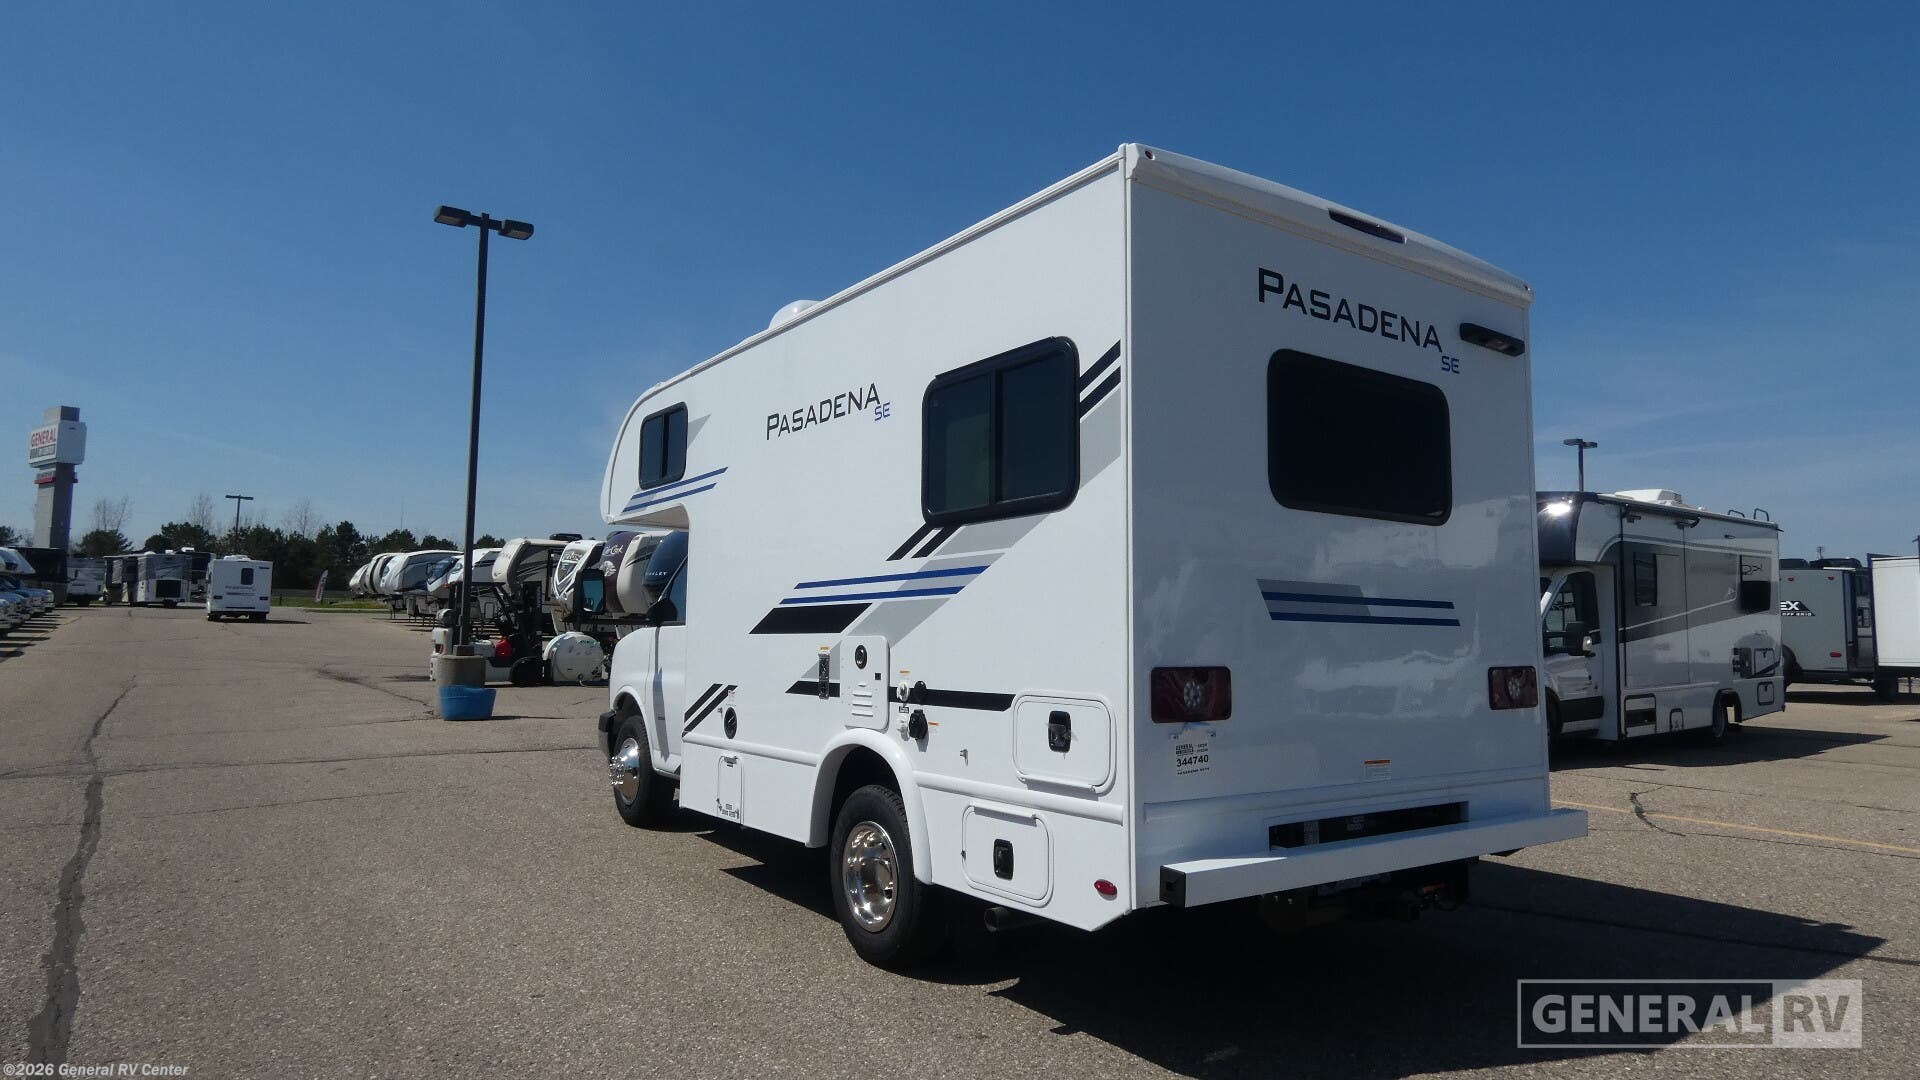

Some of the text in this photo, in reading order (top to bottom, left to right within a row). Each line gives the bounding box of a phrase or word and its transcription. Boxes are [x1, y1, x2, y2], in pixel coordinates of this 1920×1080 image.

[1258, 267, 1442, 353] PASADENA
[1441, 355, 1461, 374] SE
[766, 382, 881, 440] PASADENA
[874, 402, 890, 421] SE
[31, 427, 56, 447] GENERAL
[1176, 754, 1209, 767] 344740
